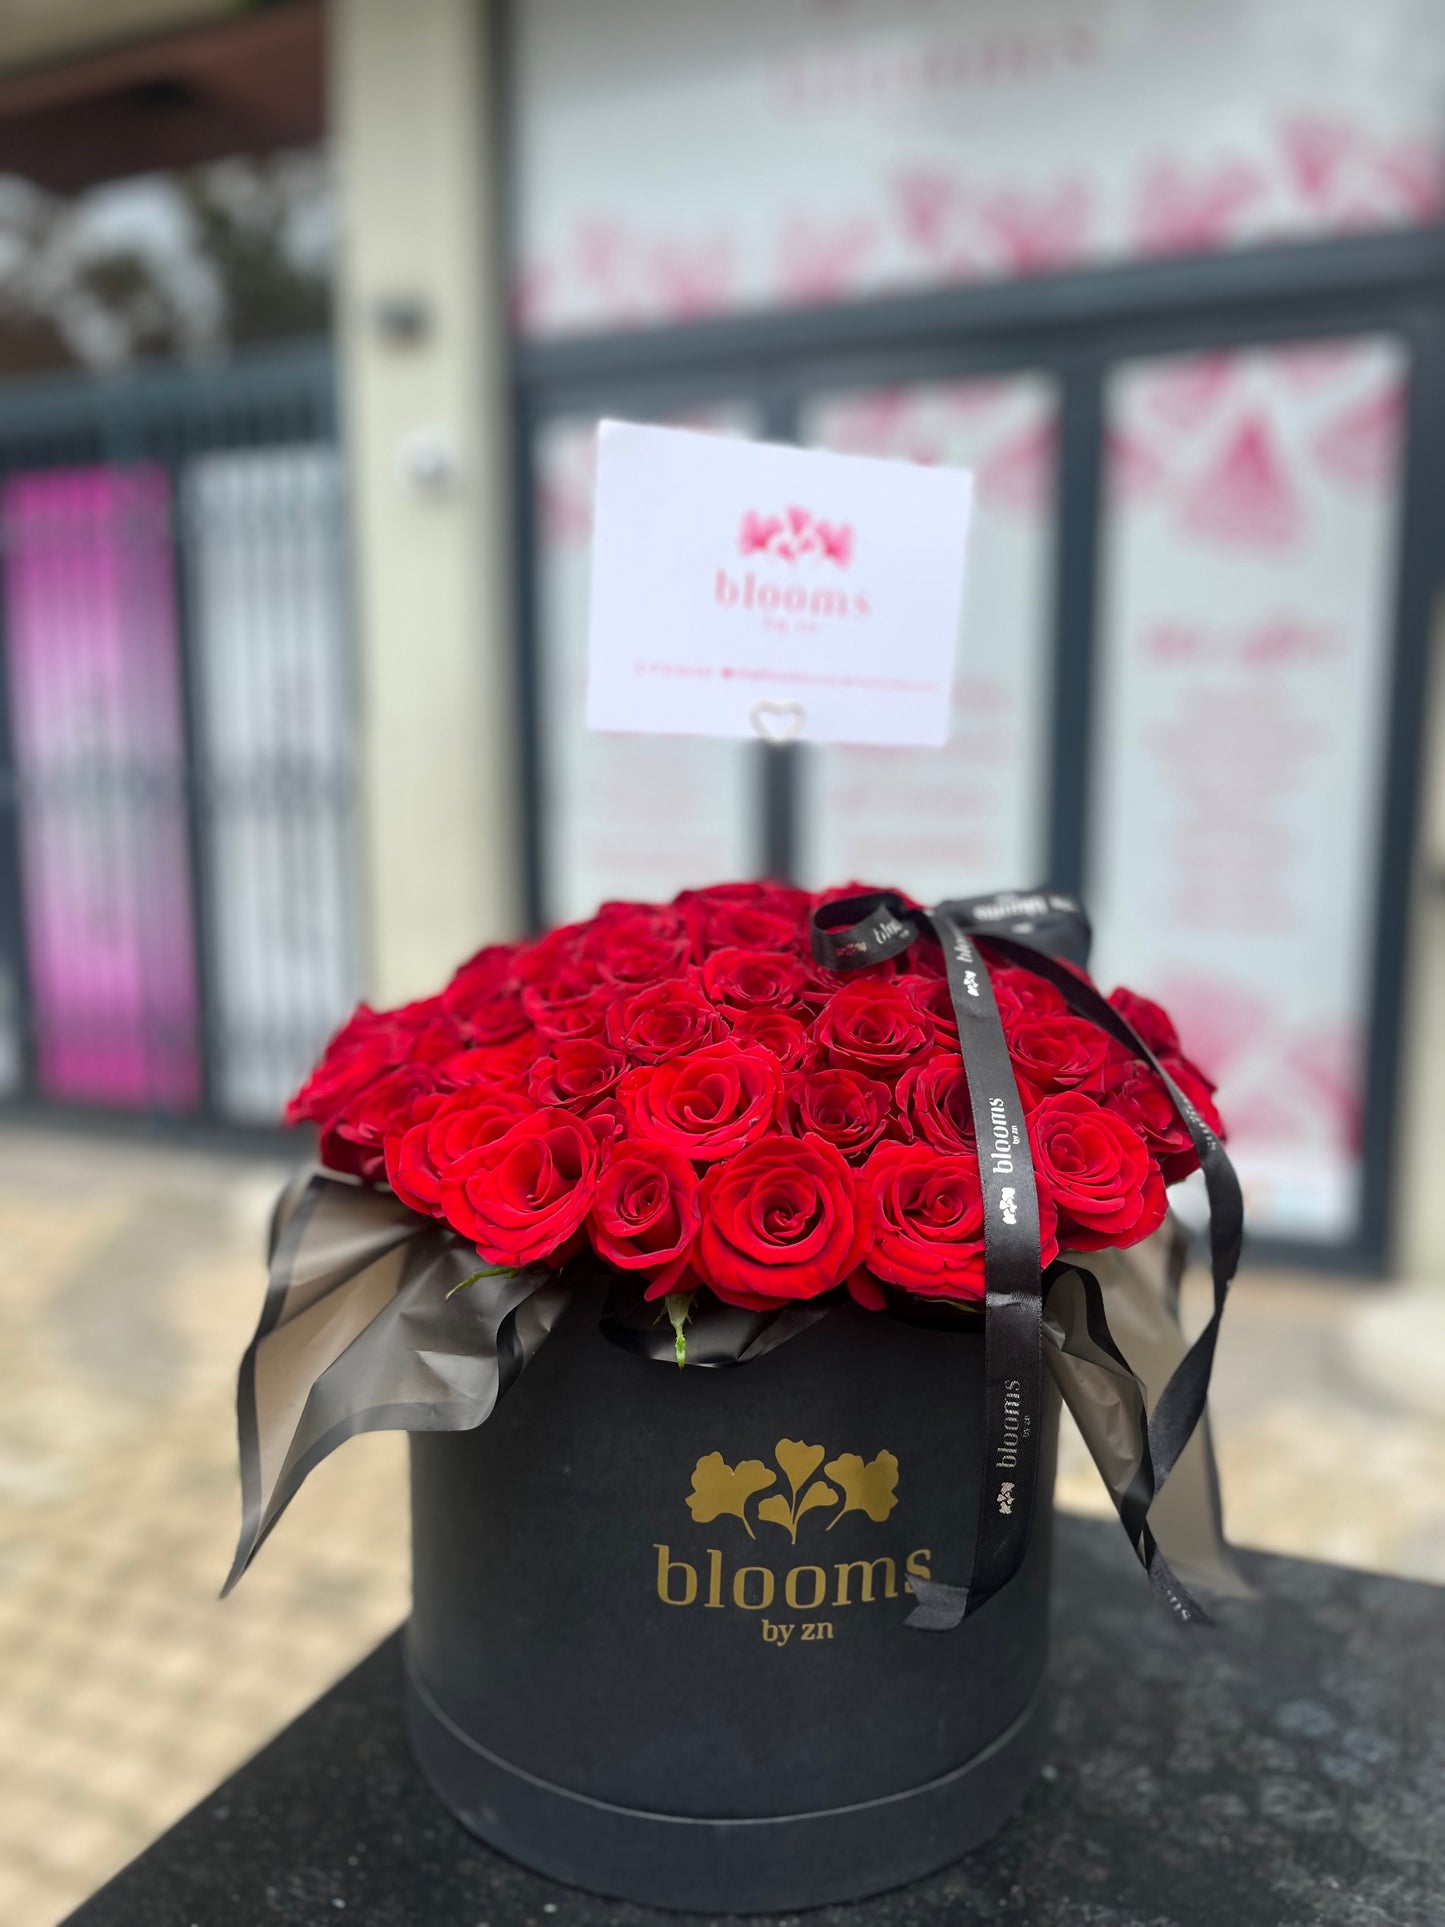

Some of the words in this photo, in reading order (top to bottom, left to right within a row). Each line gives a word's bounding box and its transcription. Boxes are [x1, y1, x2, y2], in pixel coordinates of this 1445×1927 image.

[714, 567, 871, 618] blooms
[989, 1097, 1014, 1174] blooms
[995, 1379, 1021, 1469] blooms
[653, 1543, 932, 1611] blooms
[761, 1618, 795, 1647] by
[801, 1621, 834, 1641] zn
